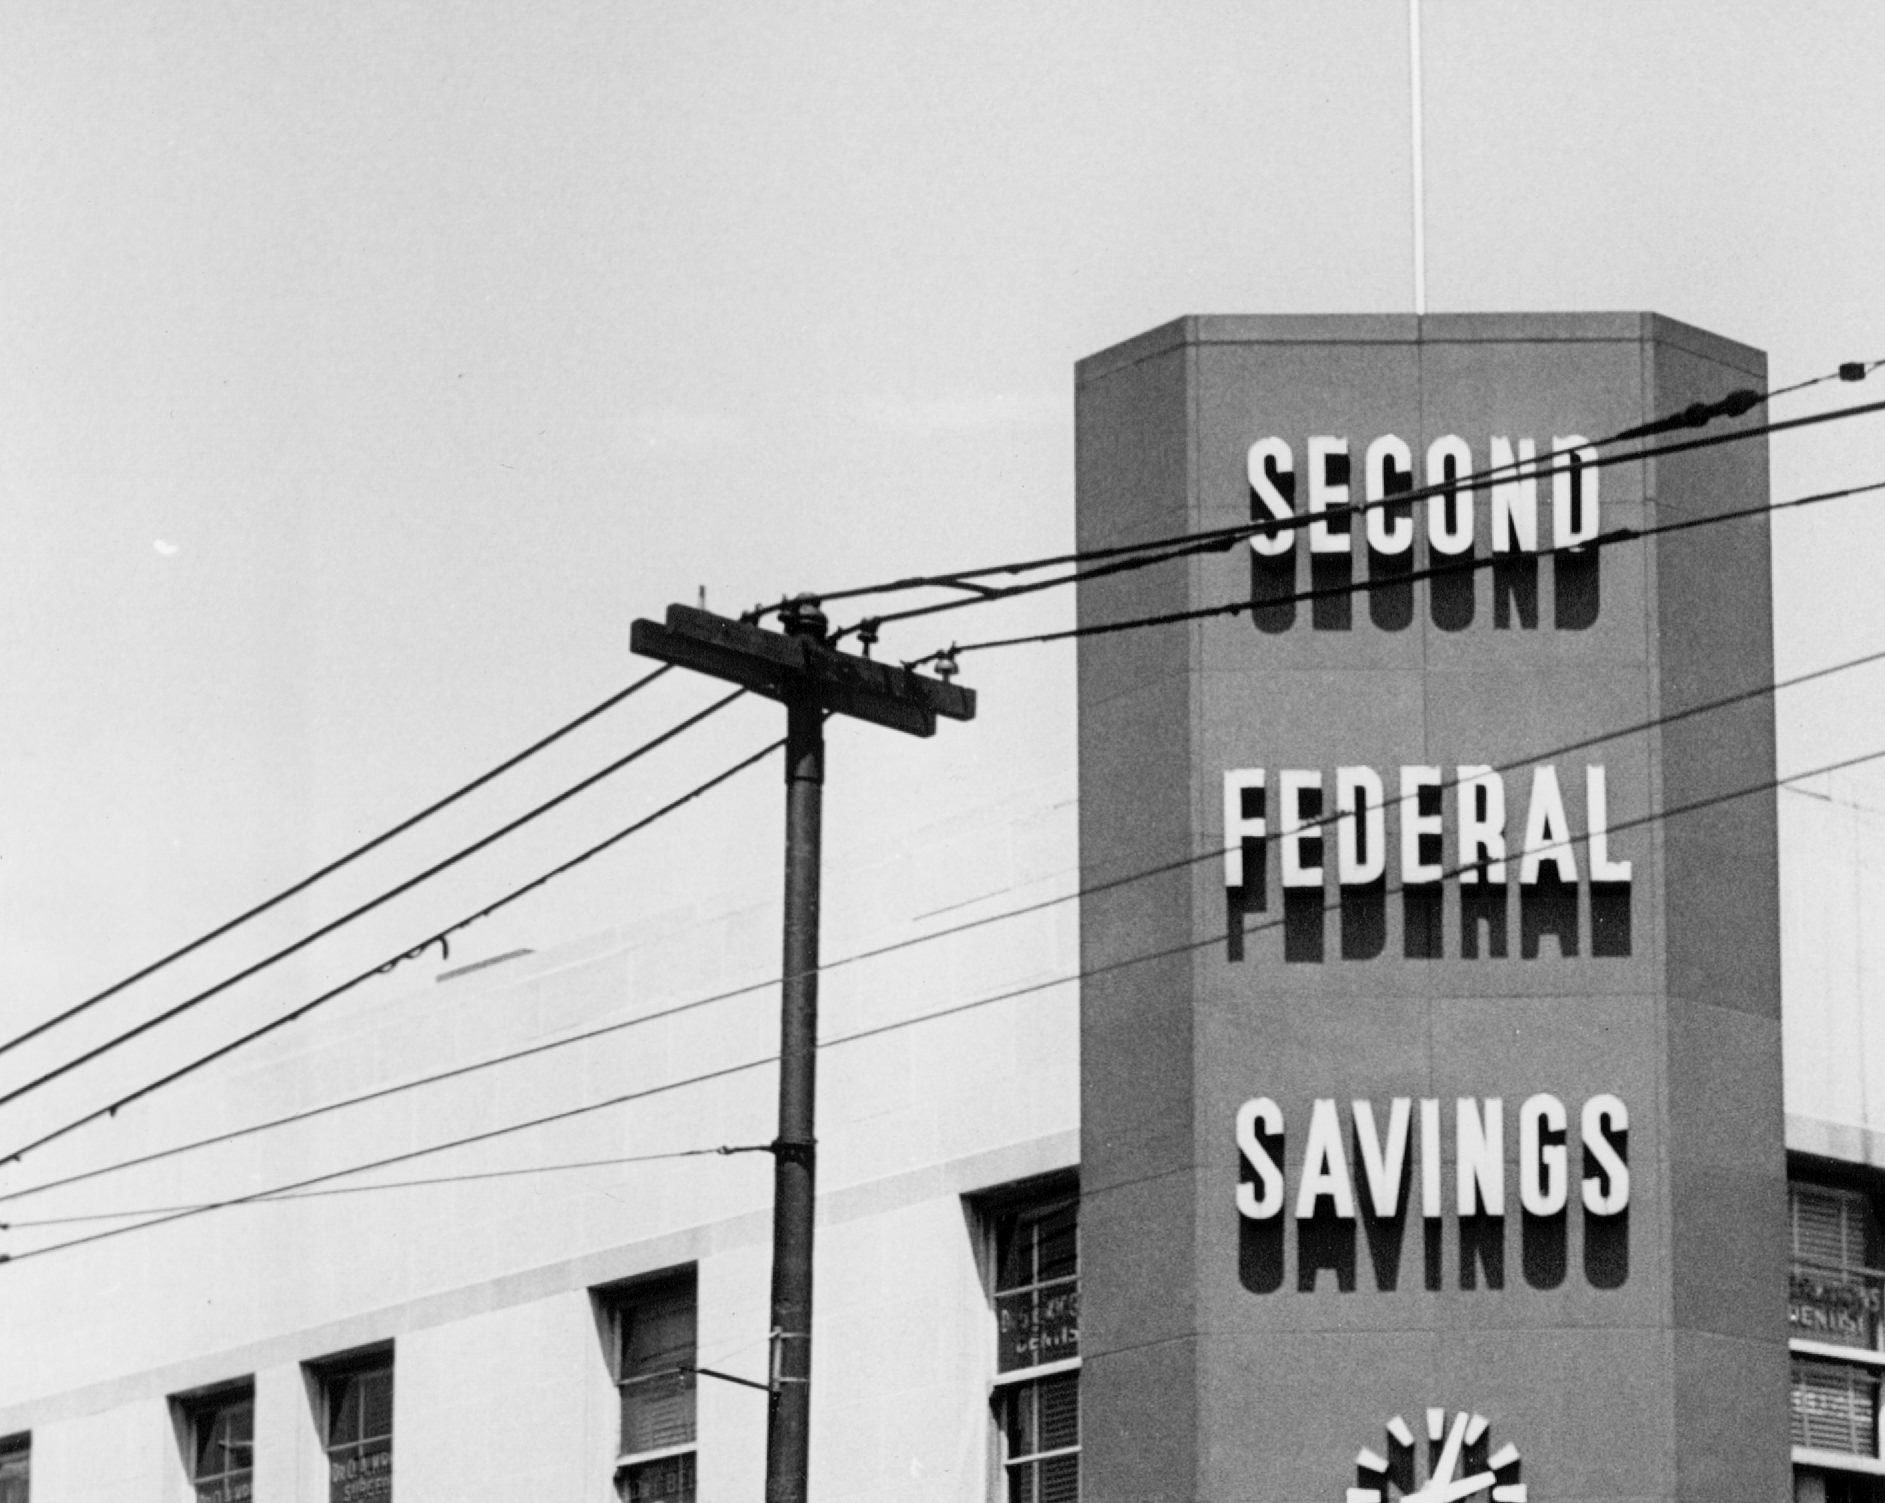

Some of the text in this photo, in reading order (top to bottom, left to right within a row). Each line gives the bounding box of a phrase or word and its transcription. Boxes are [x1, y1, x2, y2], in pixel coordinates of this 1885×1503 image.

[1246, 434, 1600, 556] SECOND
[1223, 764, 1633, 888] FEDERAL
[1235, 1092, 1631, 1220] SAVINGS
